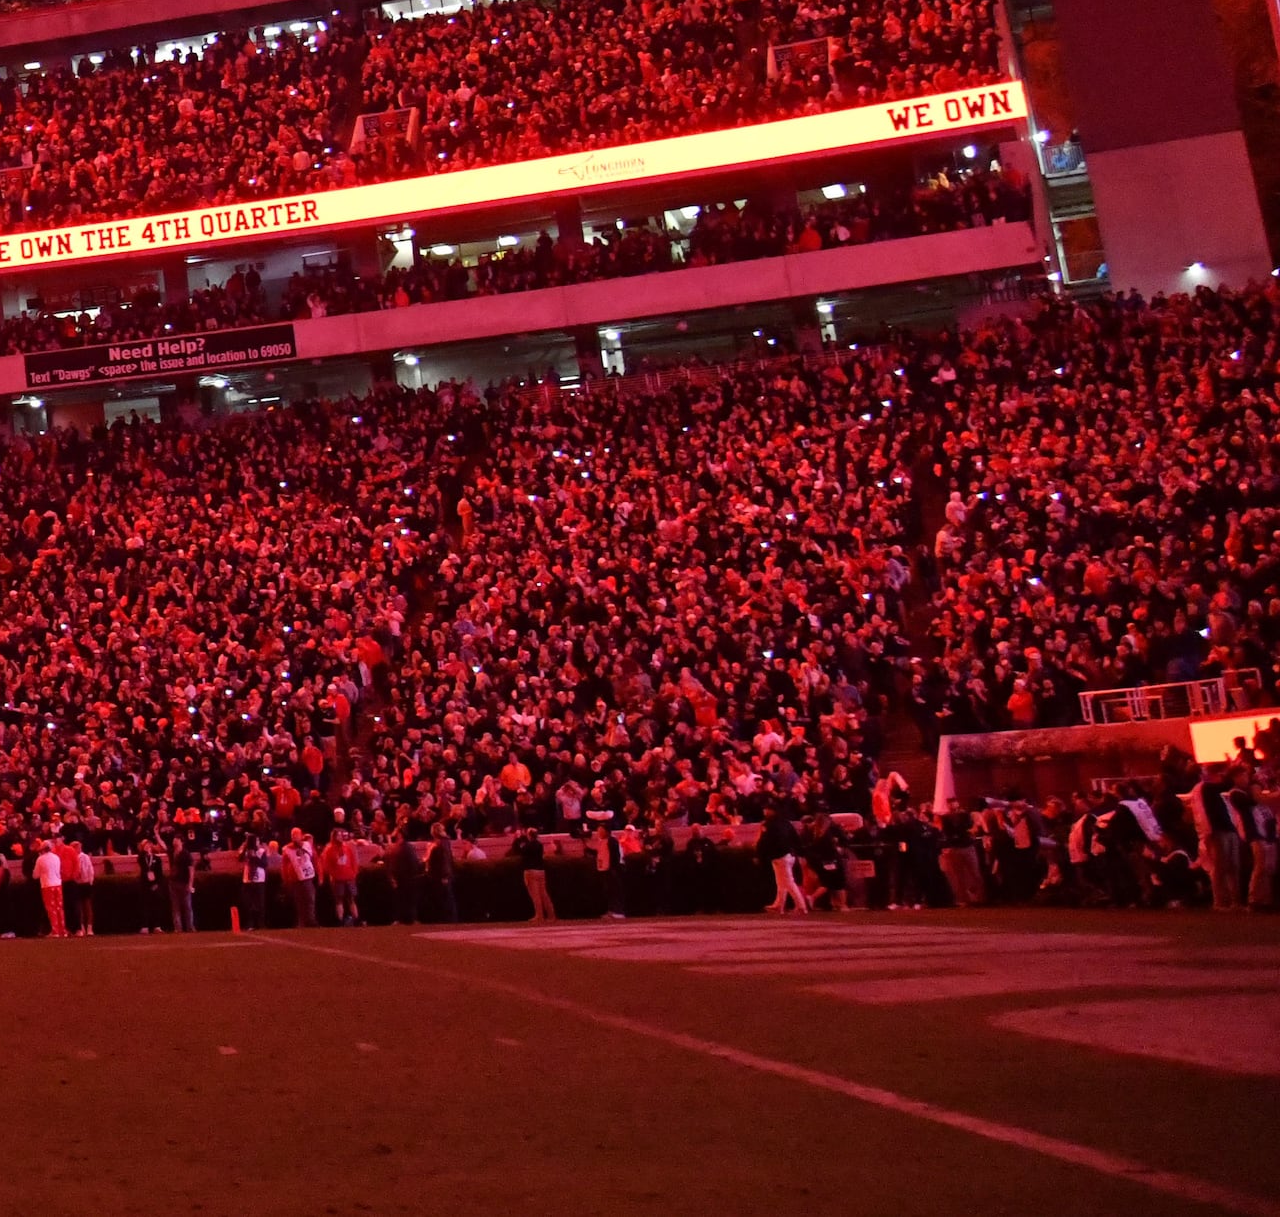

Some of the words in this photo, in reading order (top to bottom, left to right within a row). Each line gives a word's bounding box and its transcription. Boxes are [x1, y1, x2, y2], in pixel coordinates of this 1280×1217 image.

[886, 103, 933, 131] WE
[944, 89, 1013, 122] OWN
[20, 233, 73, 259] OWN
[80, 225, 131, 251] THE
[141, 216, 191, 243] 4TH
[200, 200, 319, 237] QUARTER
[30, 371, 51, 384] Text
[98, 363, 138, 377] <space>
[140, 360, 157, 372] the
[159, 358, 185, 370] issue
[186, 353, 205, 367] and
[206, 350, 246, 364] location
[247, 348, 259, 359] to
[260, 343, 292, 358] 69050
[108, 343, 153, 361] Need
[157, 338, 206, 355] Help?
